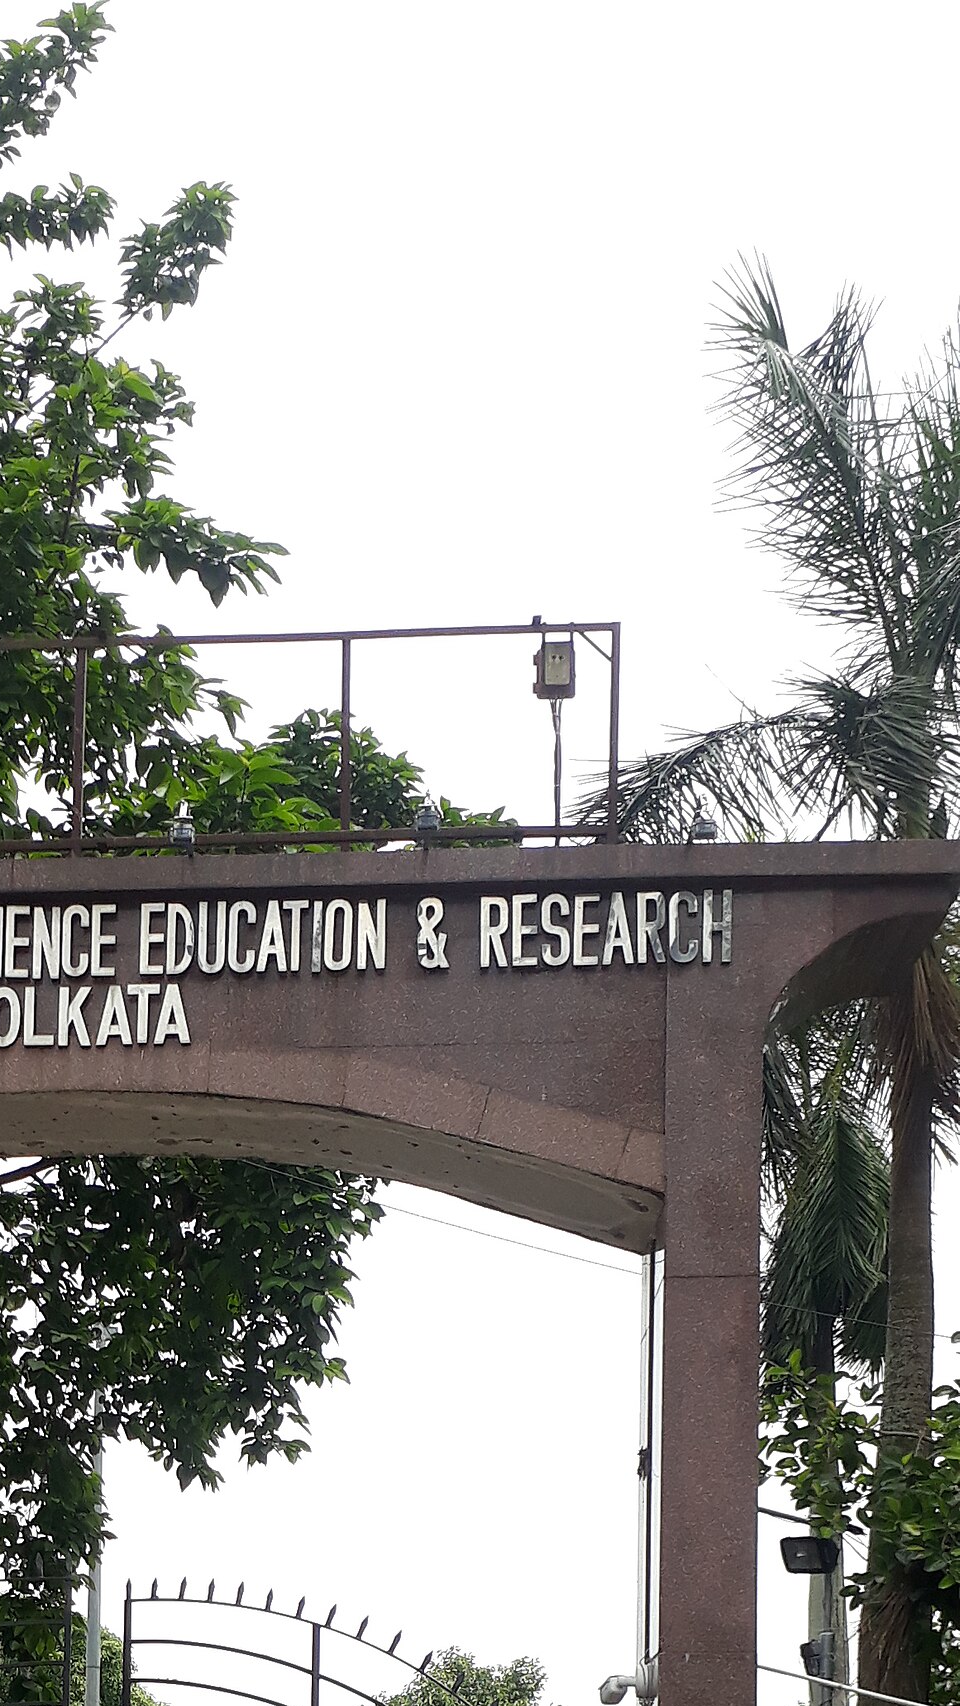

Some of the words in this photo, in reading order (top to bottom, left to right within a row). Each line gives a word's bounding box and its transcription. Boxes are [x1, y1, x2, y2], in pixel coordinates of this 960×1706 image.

[139, 899, 387, 975] EDUCATION
[416, 896, 450, 969] &
[479, 889, 733, 968] RESEARCH
